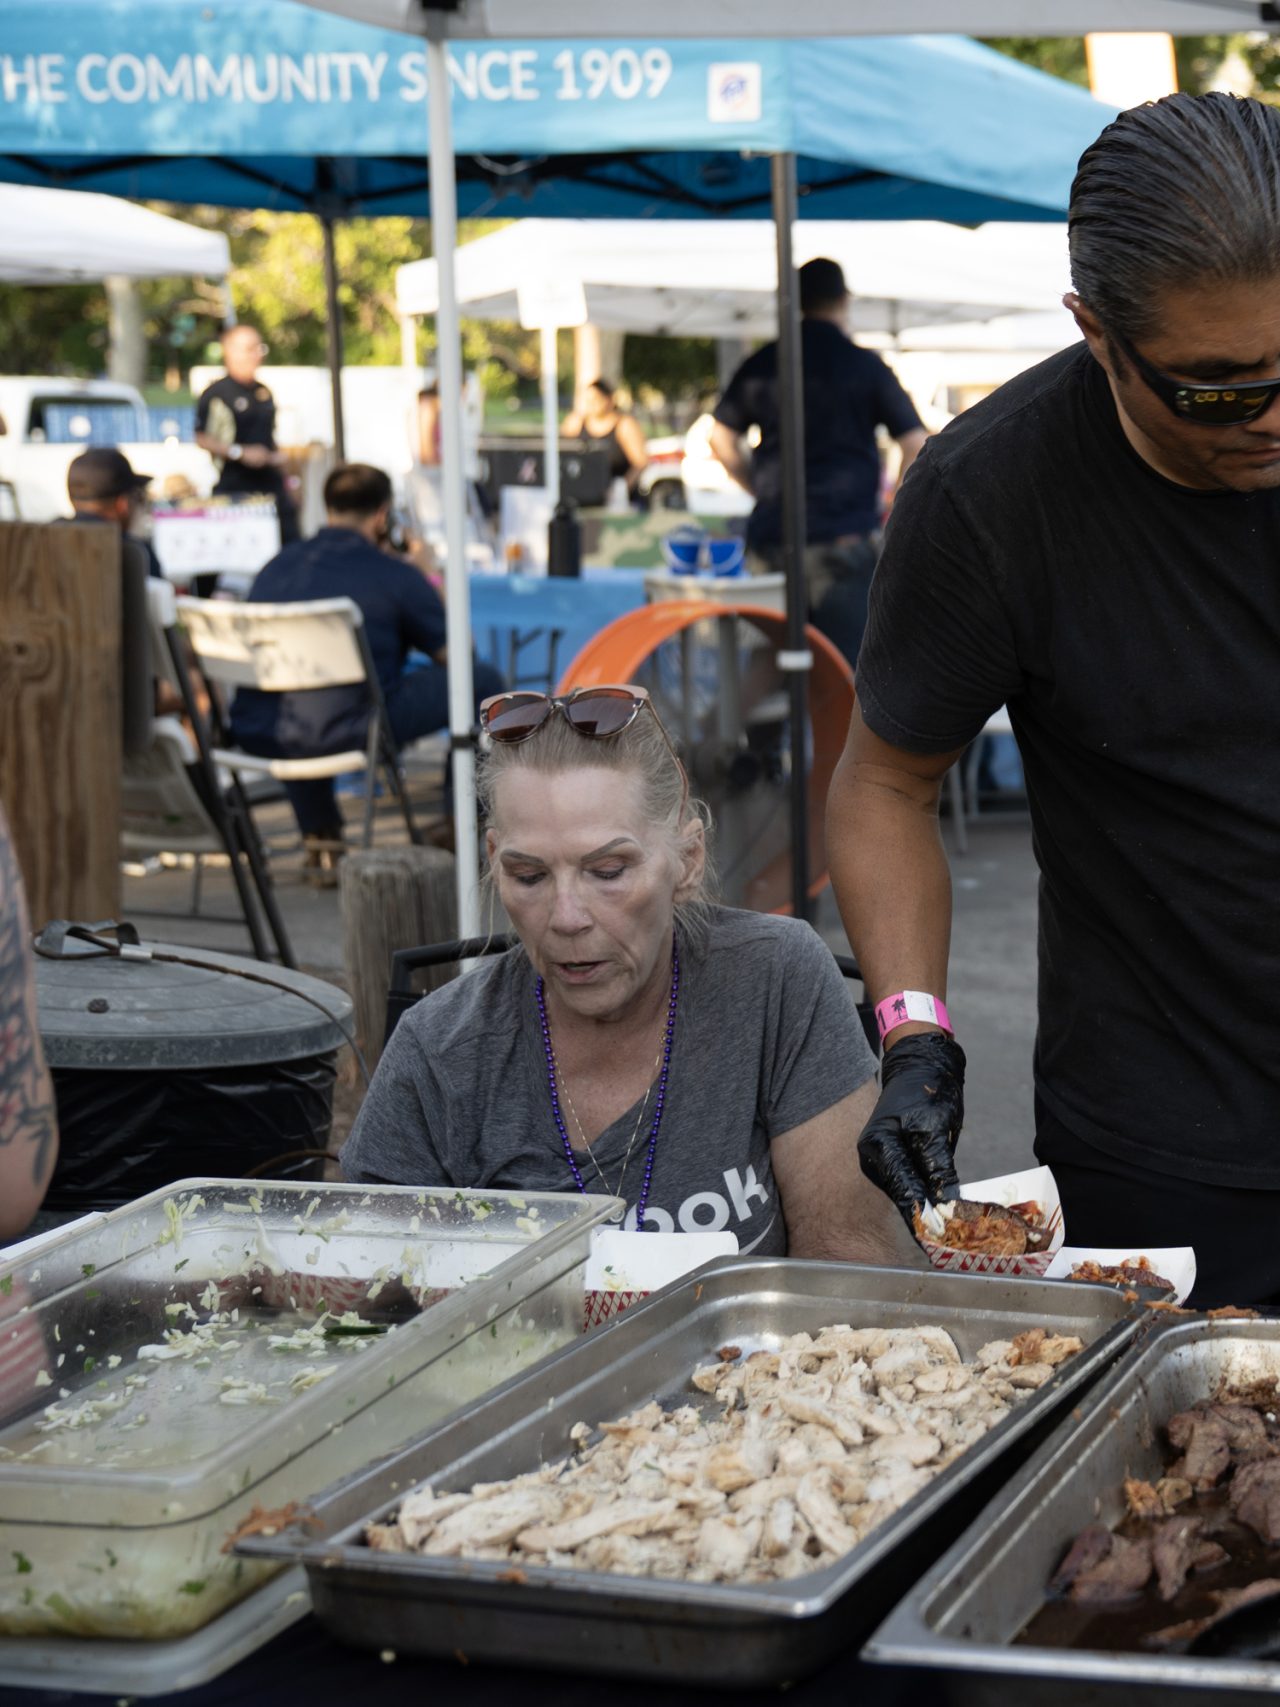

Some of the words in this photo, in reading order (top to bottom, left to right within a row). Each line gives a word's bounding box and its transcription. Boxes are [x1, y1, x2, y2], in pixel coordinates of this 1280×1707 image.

[0, 54, 67, 102] HE
[76, 52, 389, 102] COMMUNITY
[398, 49, 540, 101] SNCE
[552, 47, 673, 100] 1909
